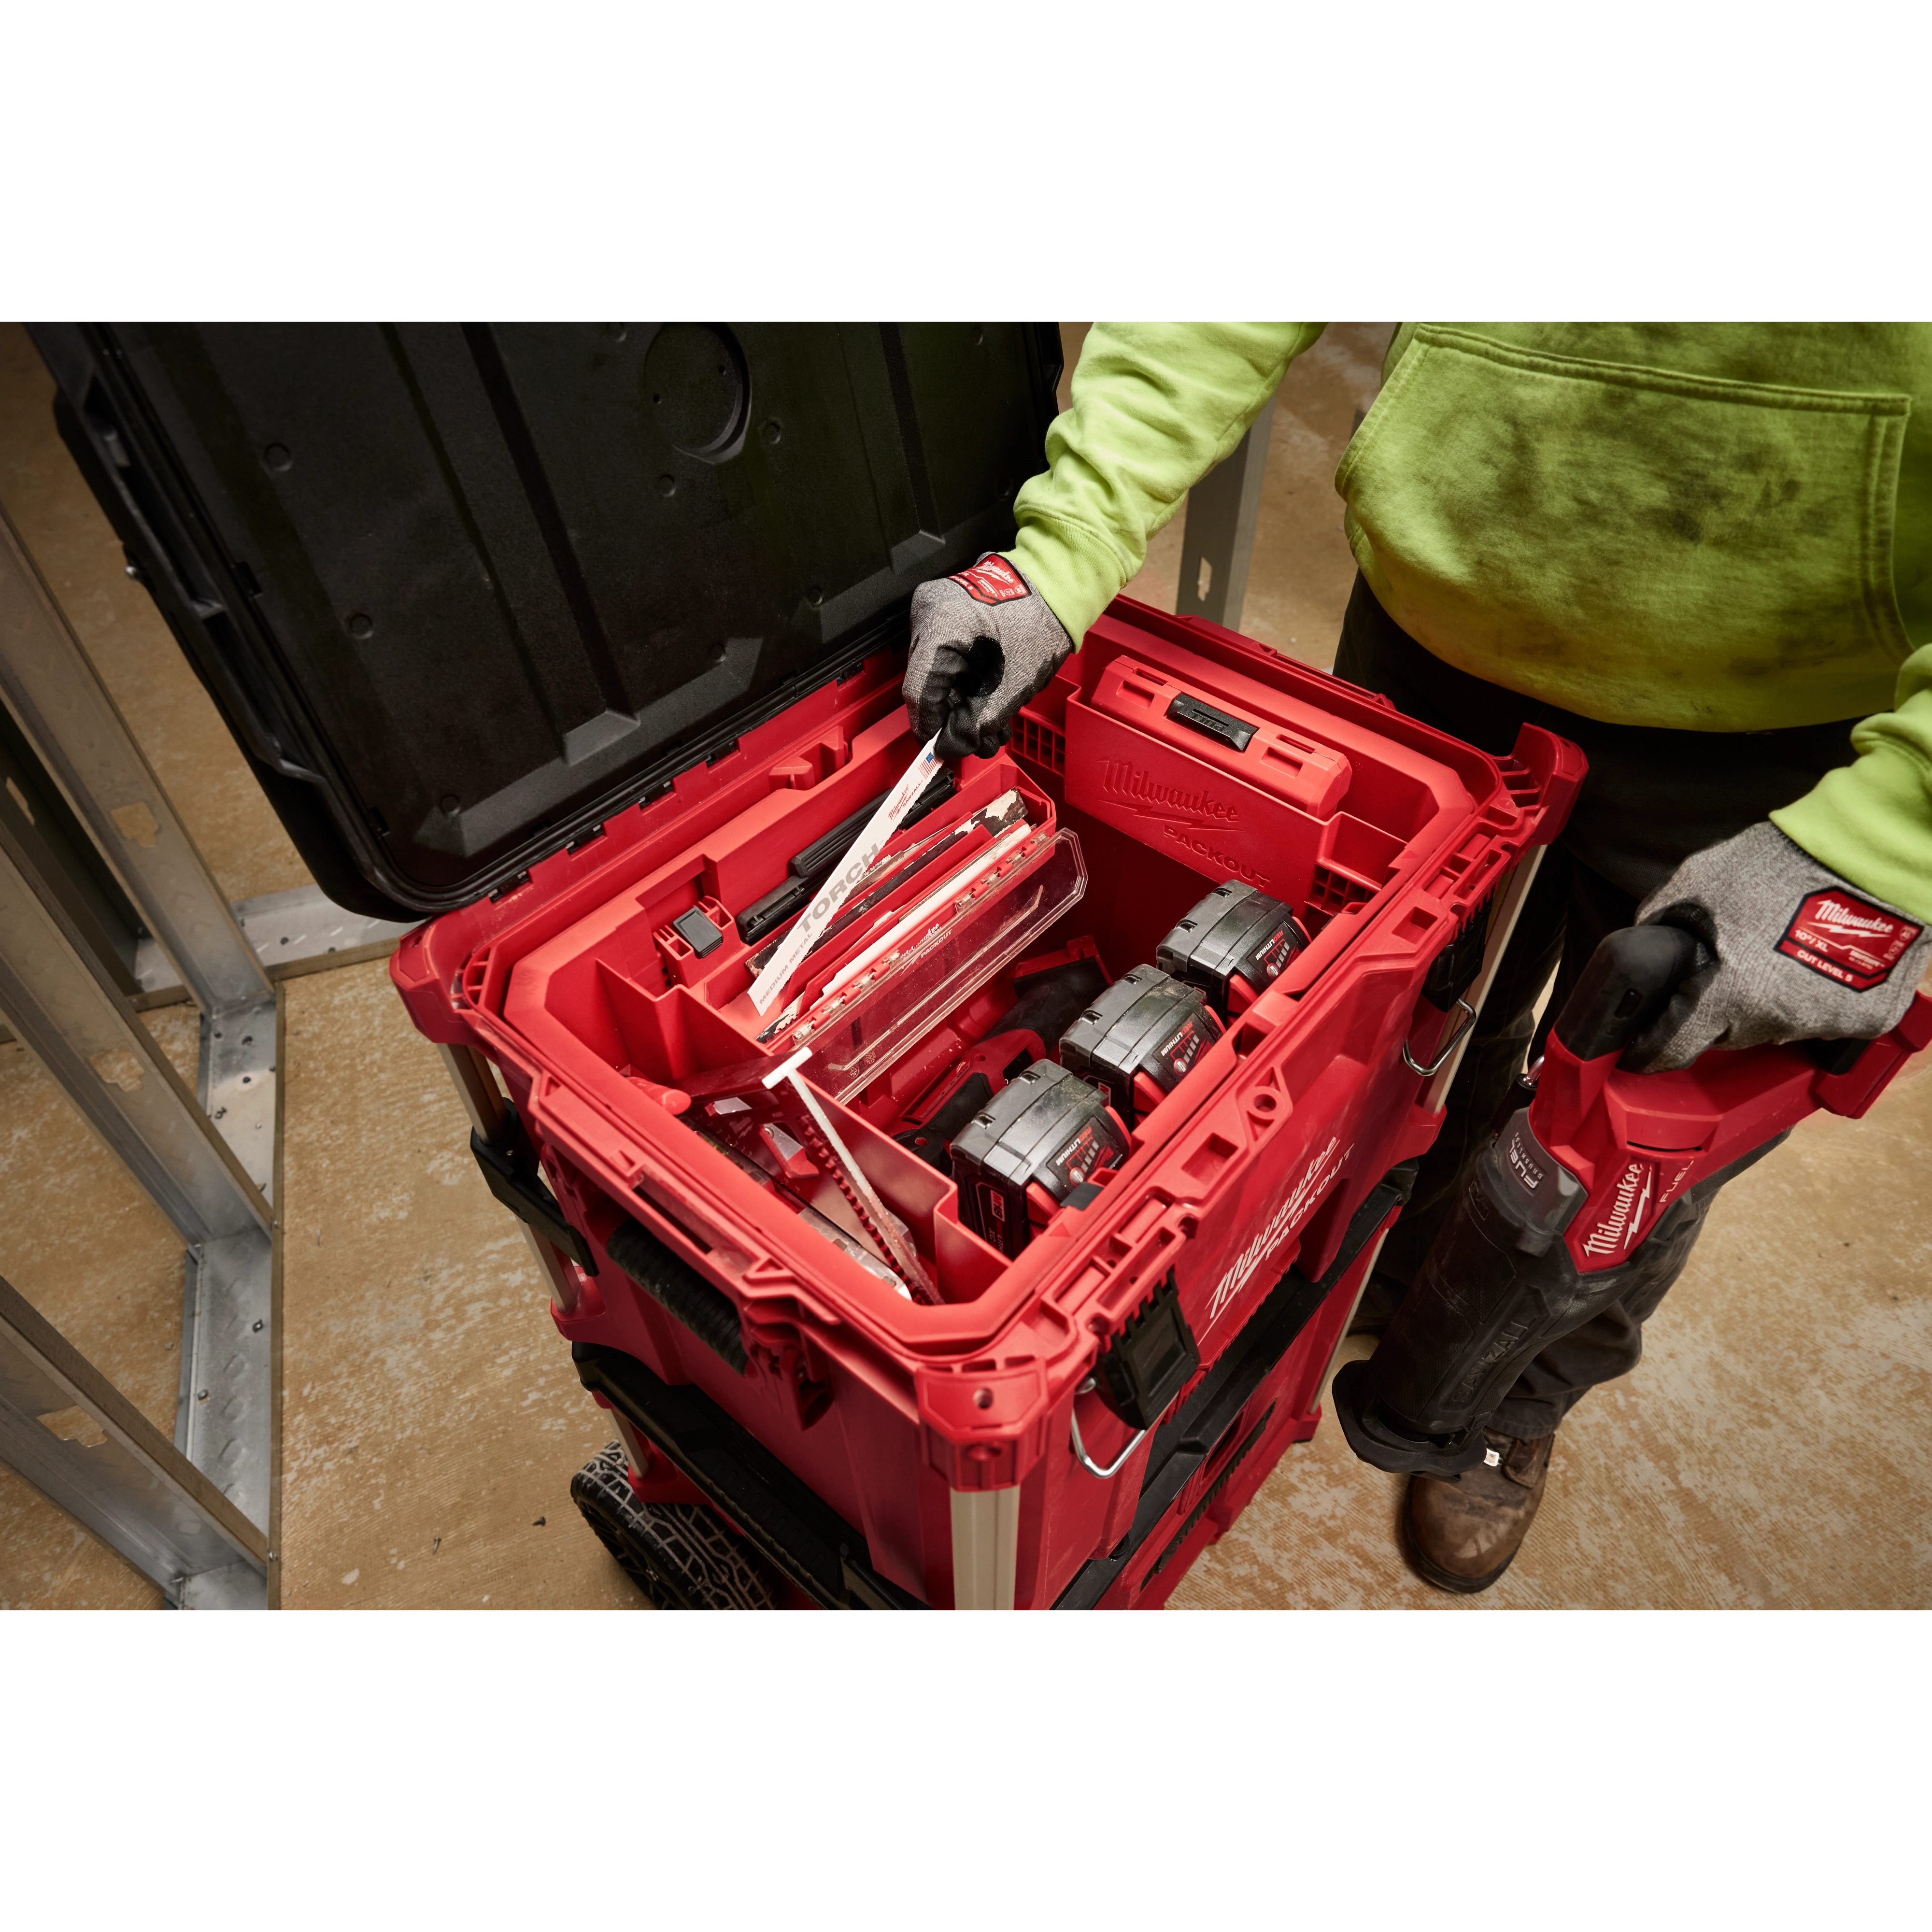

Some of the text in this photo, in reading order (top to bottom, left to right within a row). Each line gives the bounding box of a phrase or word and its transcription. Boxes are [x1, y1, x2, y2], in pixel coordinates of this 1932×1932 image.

[955, 577, 969, 586] LEVEL
[975, 560, 1014, 583] Milwaukee
[888, 786, 909, 820] Milwaukee
[902, 782, 922, 808] SAWZALL
[1097, 755, 1240, 822] Milwaukee
[1163, 824, 1271, 889] PACKOUT
[797, 842, 879, 933] TORCH
[1815, 899, 1893, 933] Milwaukee
[921, 929, 952, 958] PACKOUT
[1255, 929, 1284, 961] REDLITHIUM
[1815, 939, 1828, 952] XL
[759, 933, 812, 1005] MEDIUM METAL
[1797, 949, 1818, 965] CUT
[1817, 960, 1844, 979] LEVEL
[1845, 973, 1853, 982] 5
[1161, 1021, 1193, 1056] REDLITHIUM
[1055, 1126, 1093, 1166] REDLITHIUM
[1509, 1138, 1539, 1189] FUEL
[1659, 1160, 1694, 1202] FUEL
[1265, 1142, 1354, 1261] PACKOUT
[1582, 1164, 1644, 1257] Milwaukee
[1205, 1136, 1338, 1319] Milwaukee
